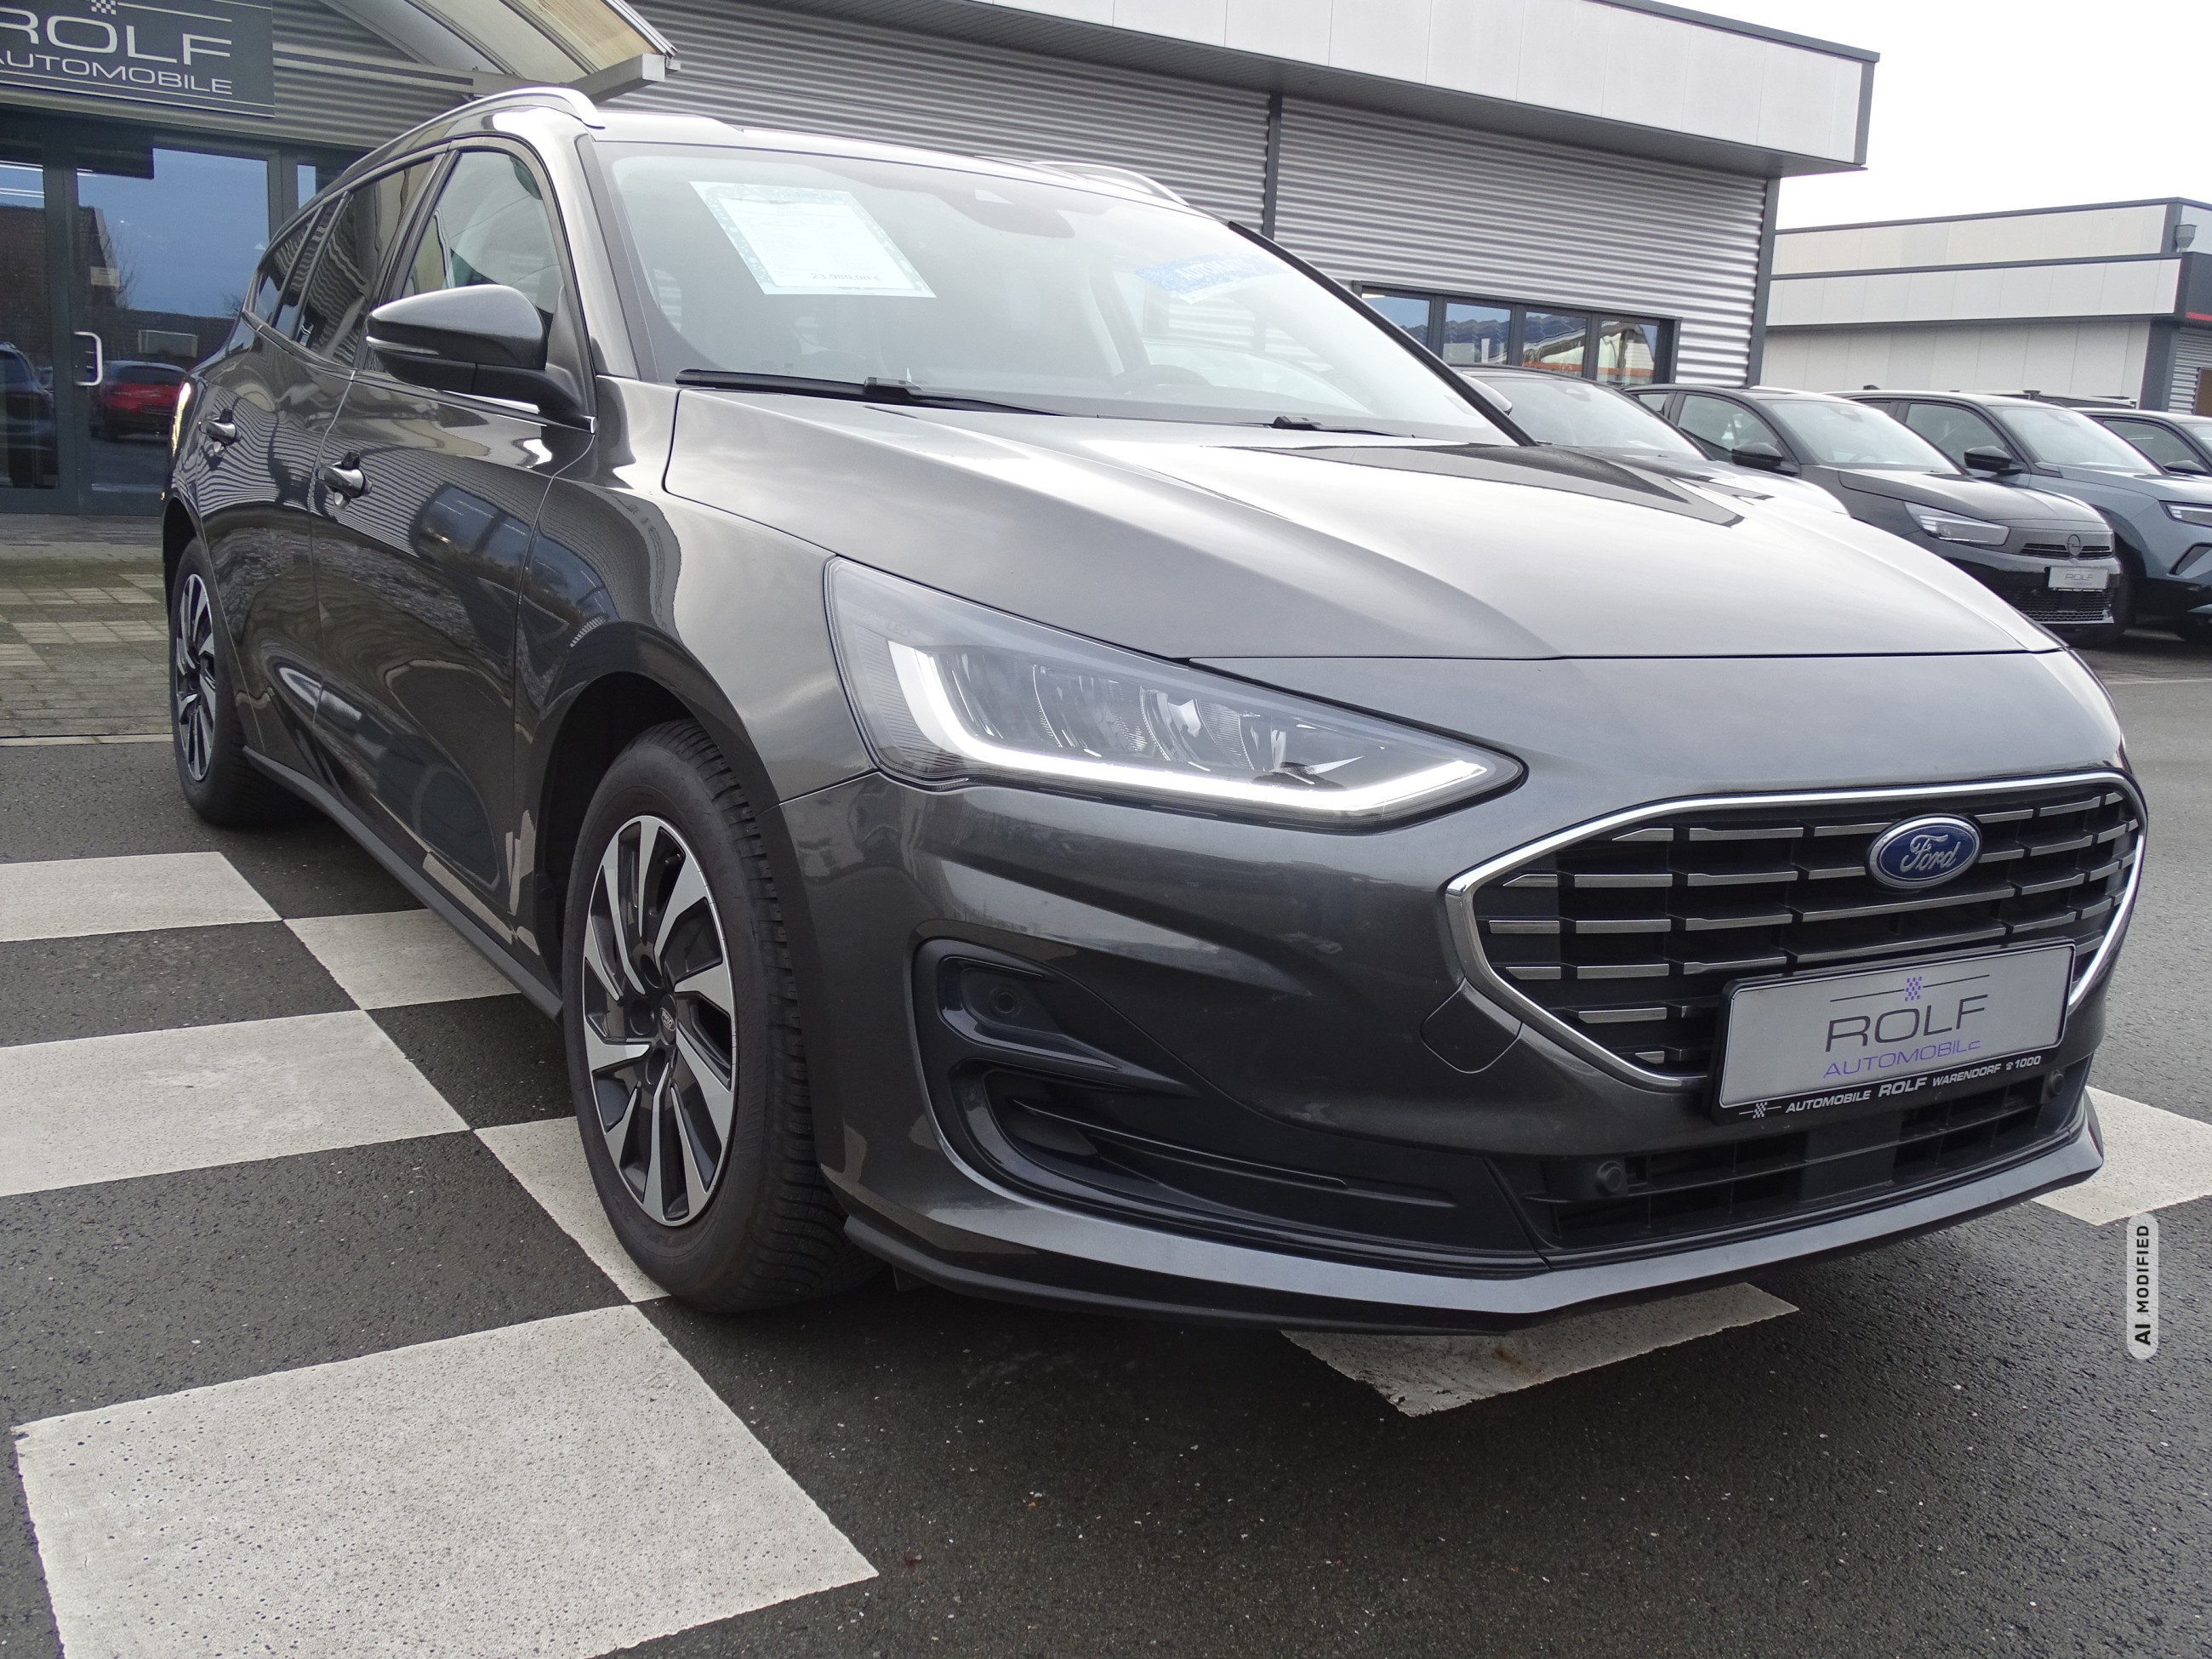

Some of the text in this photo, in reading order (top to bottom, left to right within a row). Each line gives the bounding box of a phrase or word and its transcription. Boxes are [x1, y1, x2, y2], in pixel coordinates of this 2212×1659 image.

[0, 7, 232, 66] ROLF
[0, 50, 233, 95] UTOMOBILE
[1900, 834, 1961, 872] Ford
[1825, 994, 1988, 1053] ROLF
[1786, 1089, 1872, 1114] AUTOMOBILE
[1878, 1076, 1928, 1098] ROLF
[1932, 1063, 2002, 1087] WARENDORF
